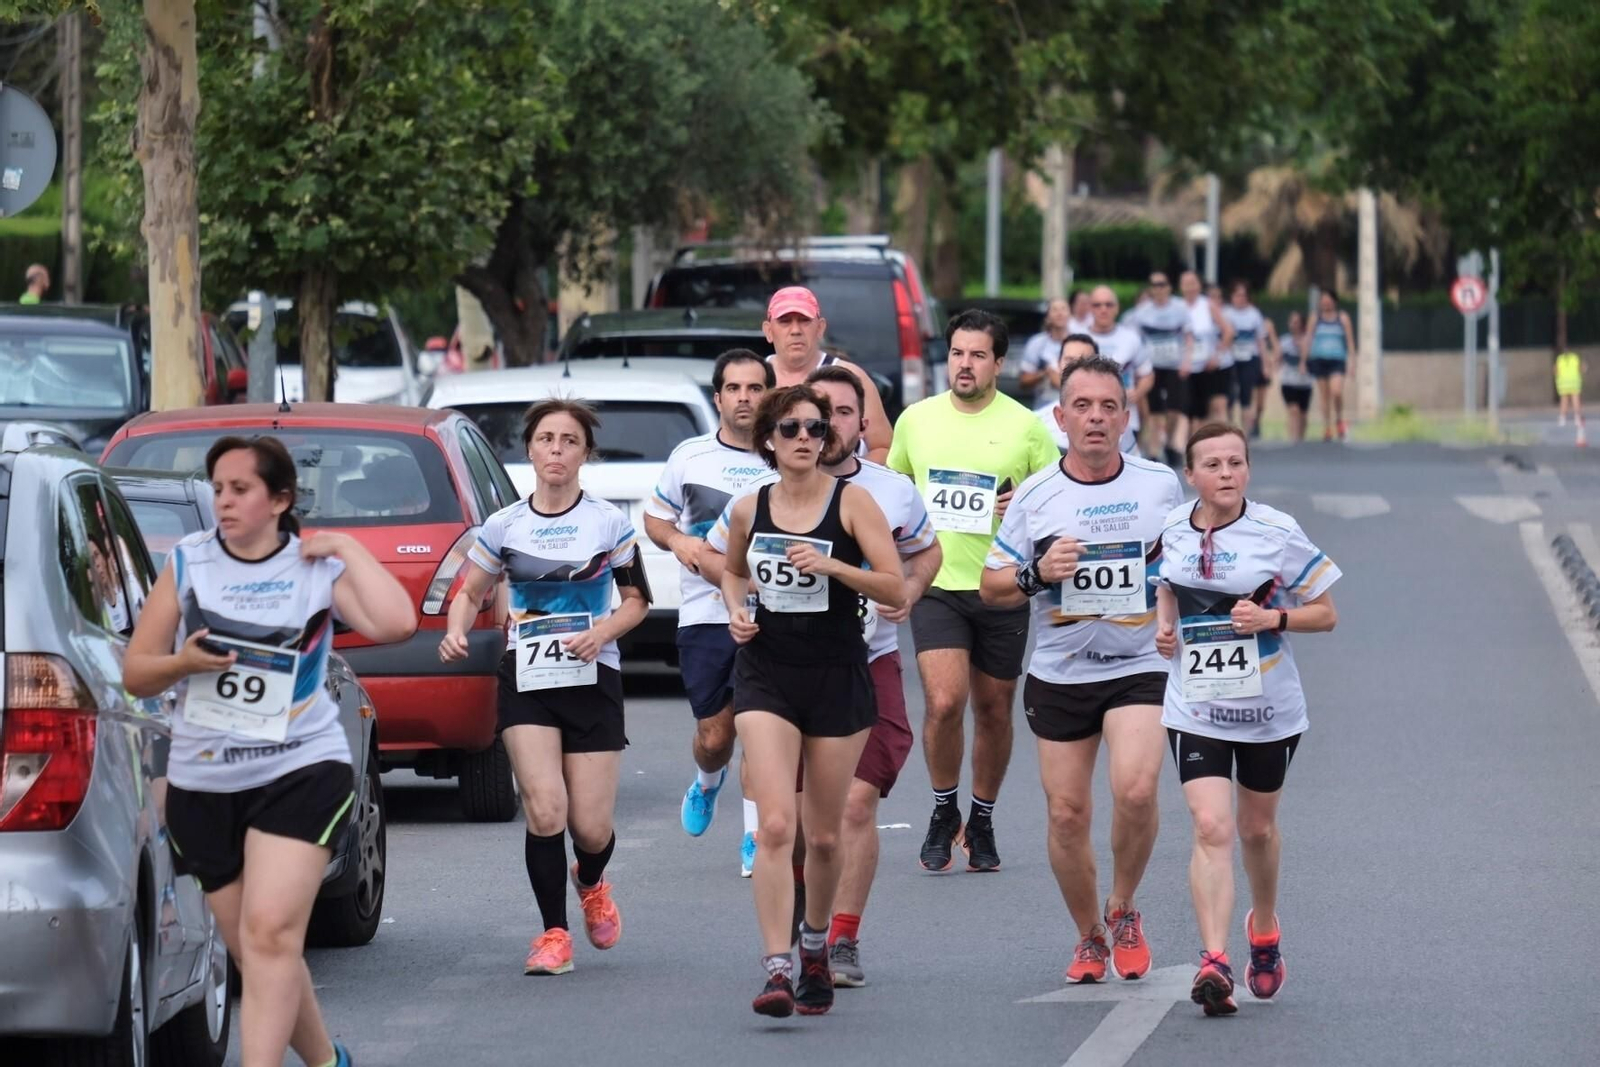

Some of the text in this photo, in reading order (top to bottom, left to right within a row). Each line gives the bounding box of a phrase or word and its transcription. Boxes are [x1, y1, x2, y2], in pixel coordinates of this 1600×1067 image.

[932, 488, 985, 512] 406
[1082, 501, 1139, 519] CARRERA
[535, 525, 579, 538] CARRERA
[1090, 521, 1130, 534] EN SALUD
[547, 541, 569, 550] SALUD
[756, 560, 817, 588] 655
[1073, 565, 1134, 590] 601
[1189, 646, 1248, 675] 244
[216, 672, 266, 703] 69
[1209, 706, 1275, 723] IMIBIC
